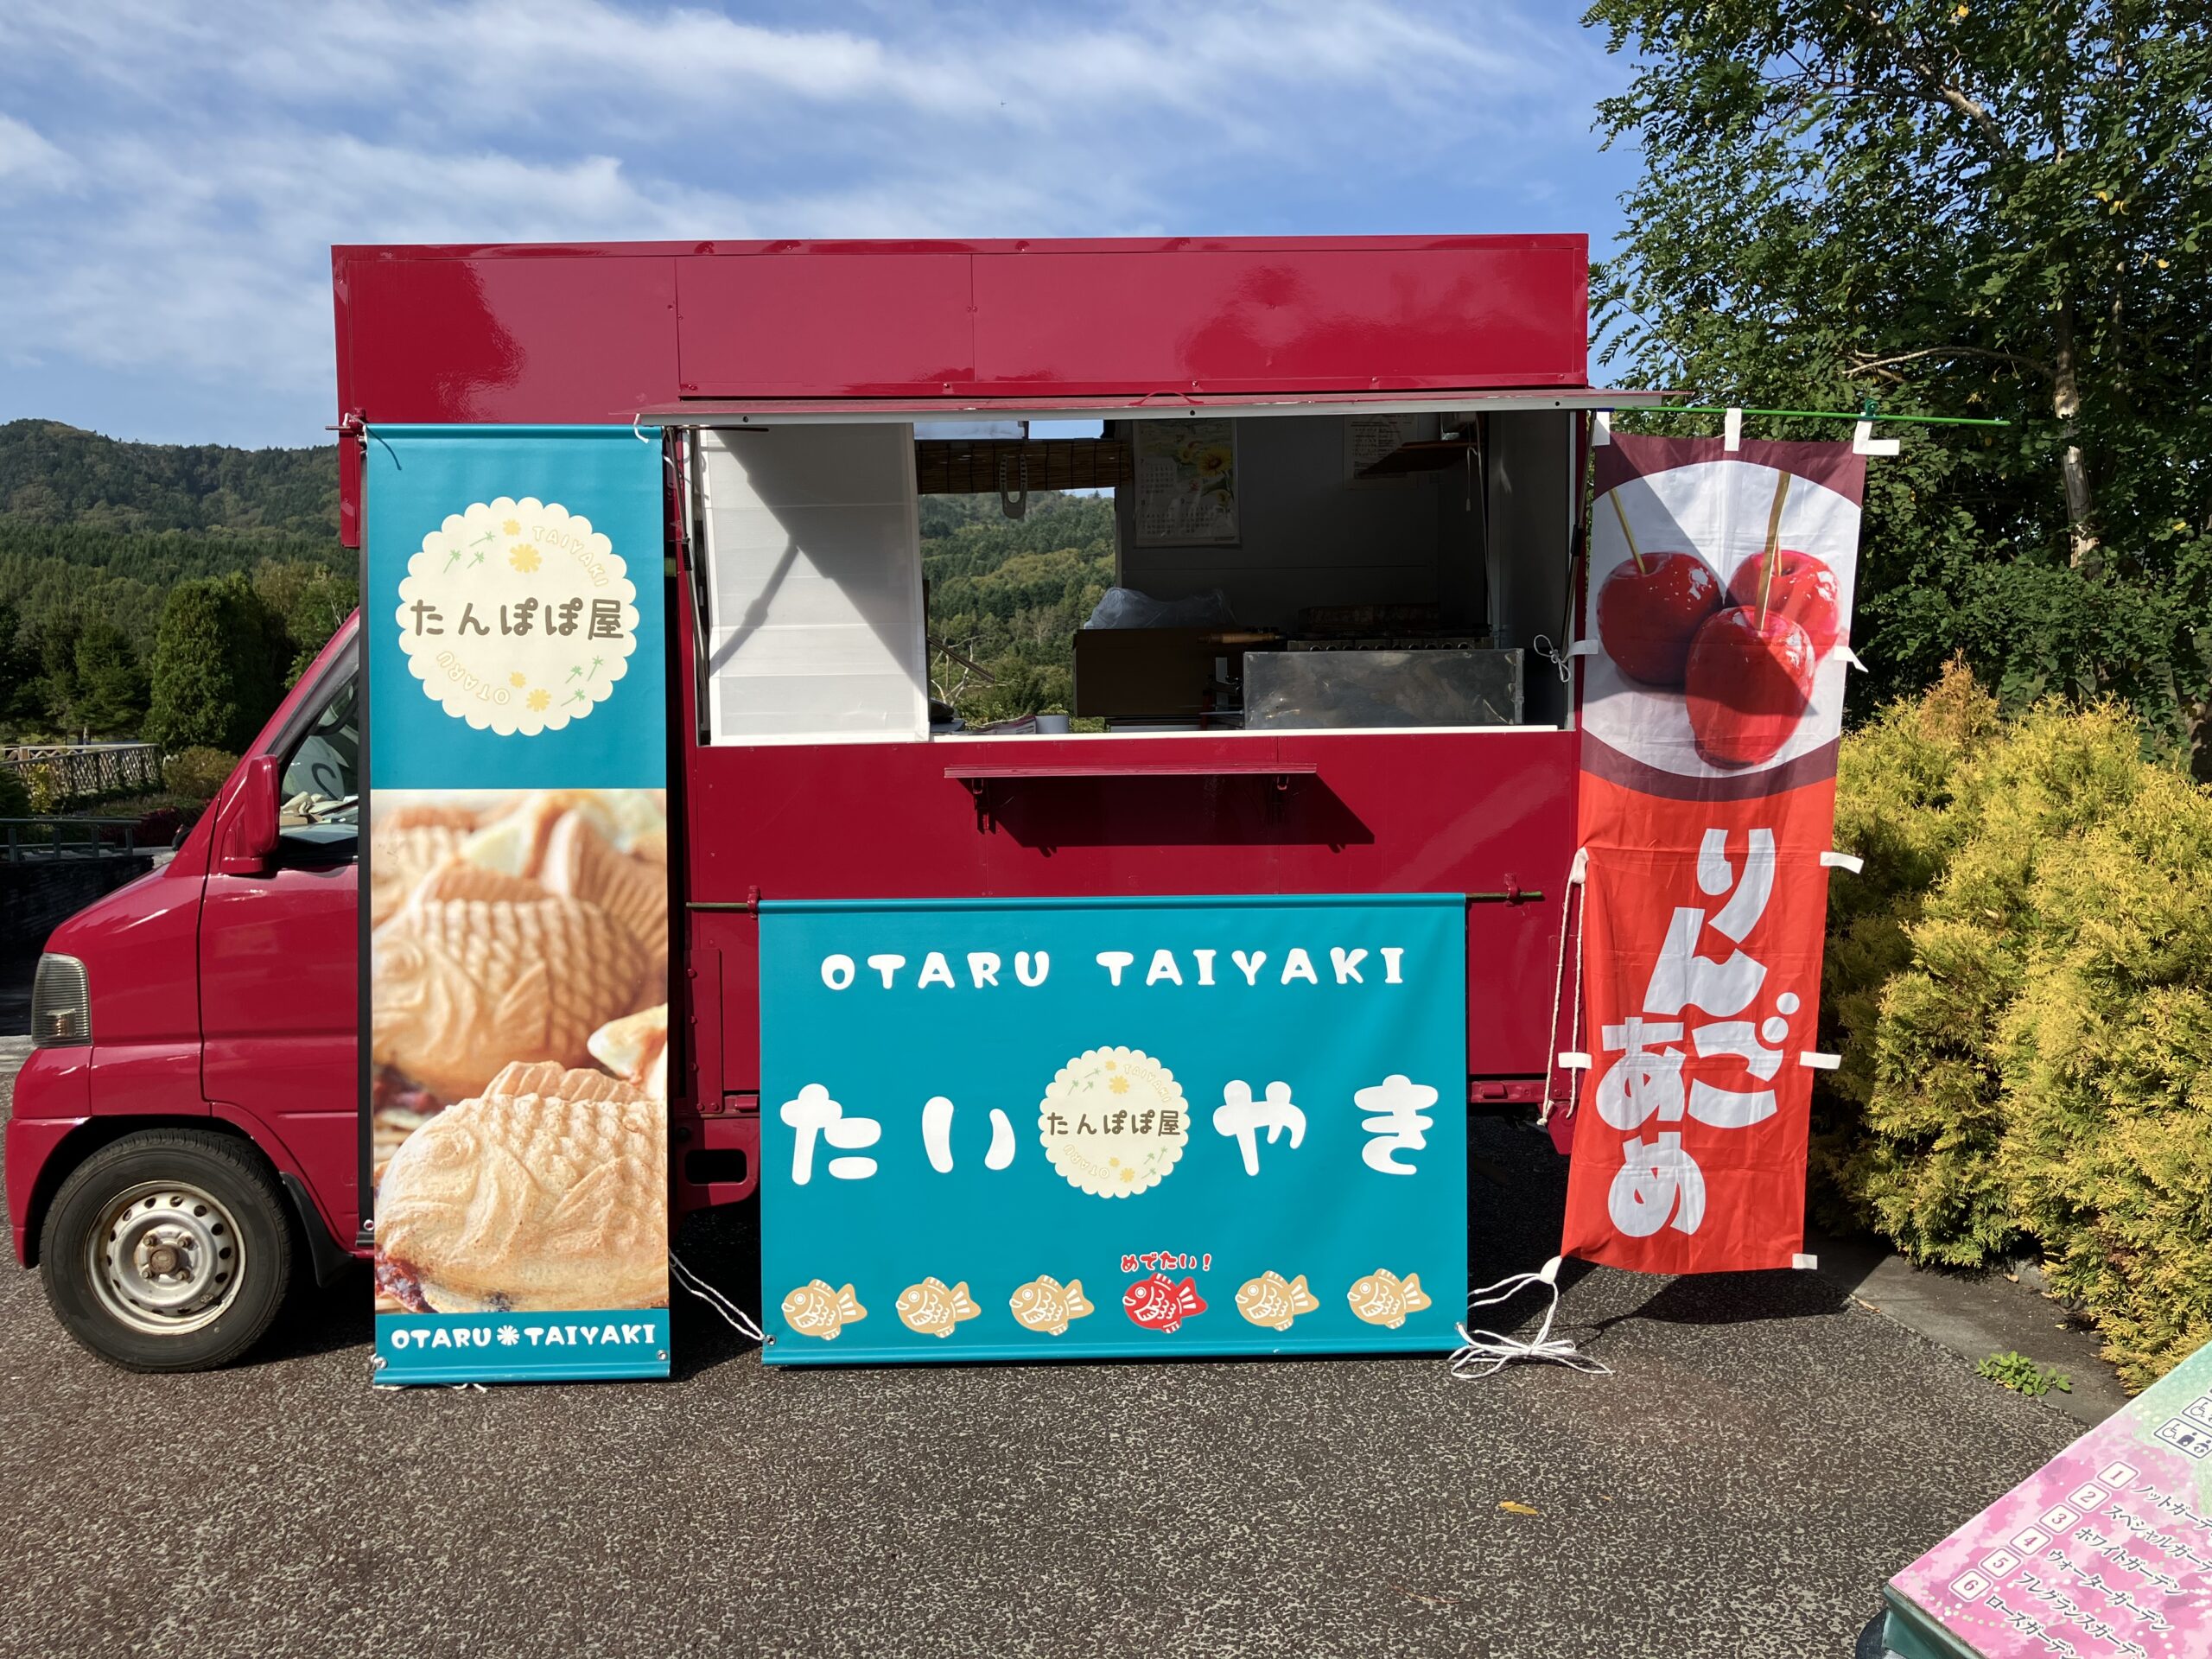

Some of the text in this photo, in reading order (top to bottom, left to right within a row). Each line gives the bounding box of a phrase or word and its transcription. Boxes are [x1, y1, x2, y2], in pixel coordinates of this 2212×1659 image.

[532, 525, 610, 588] TAIYAKI
[410, 597, 625, 641] たんぽぽ屋
[435, 651, 512, 706] OTARU
[820, 946, 1406, 991] OTARU TAIYAKI
[1123, 1064, 1173, 1103] TAIYAKI
[1047, 1109, 1181, 1137] たんぽぽ屋
[1064, 1144, 1110, 1179] OTARU
[391, 1324, 657, 1349] OTARU TAIYAKI
[2080, 1491, 2096, 1503] 2
[2110, 1471, 2212, 1532] 1 ノットガーデ
[1993, 1557, 2009, 1569] 5
[2051, 1513, 2186, 1594] 3 ホワイトガーデン
[1963, 1580, 1979, 1591] 6
[2024, 1536, 2173, 1630] 4 ウォーターガーデン
